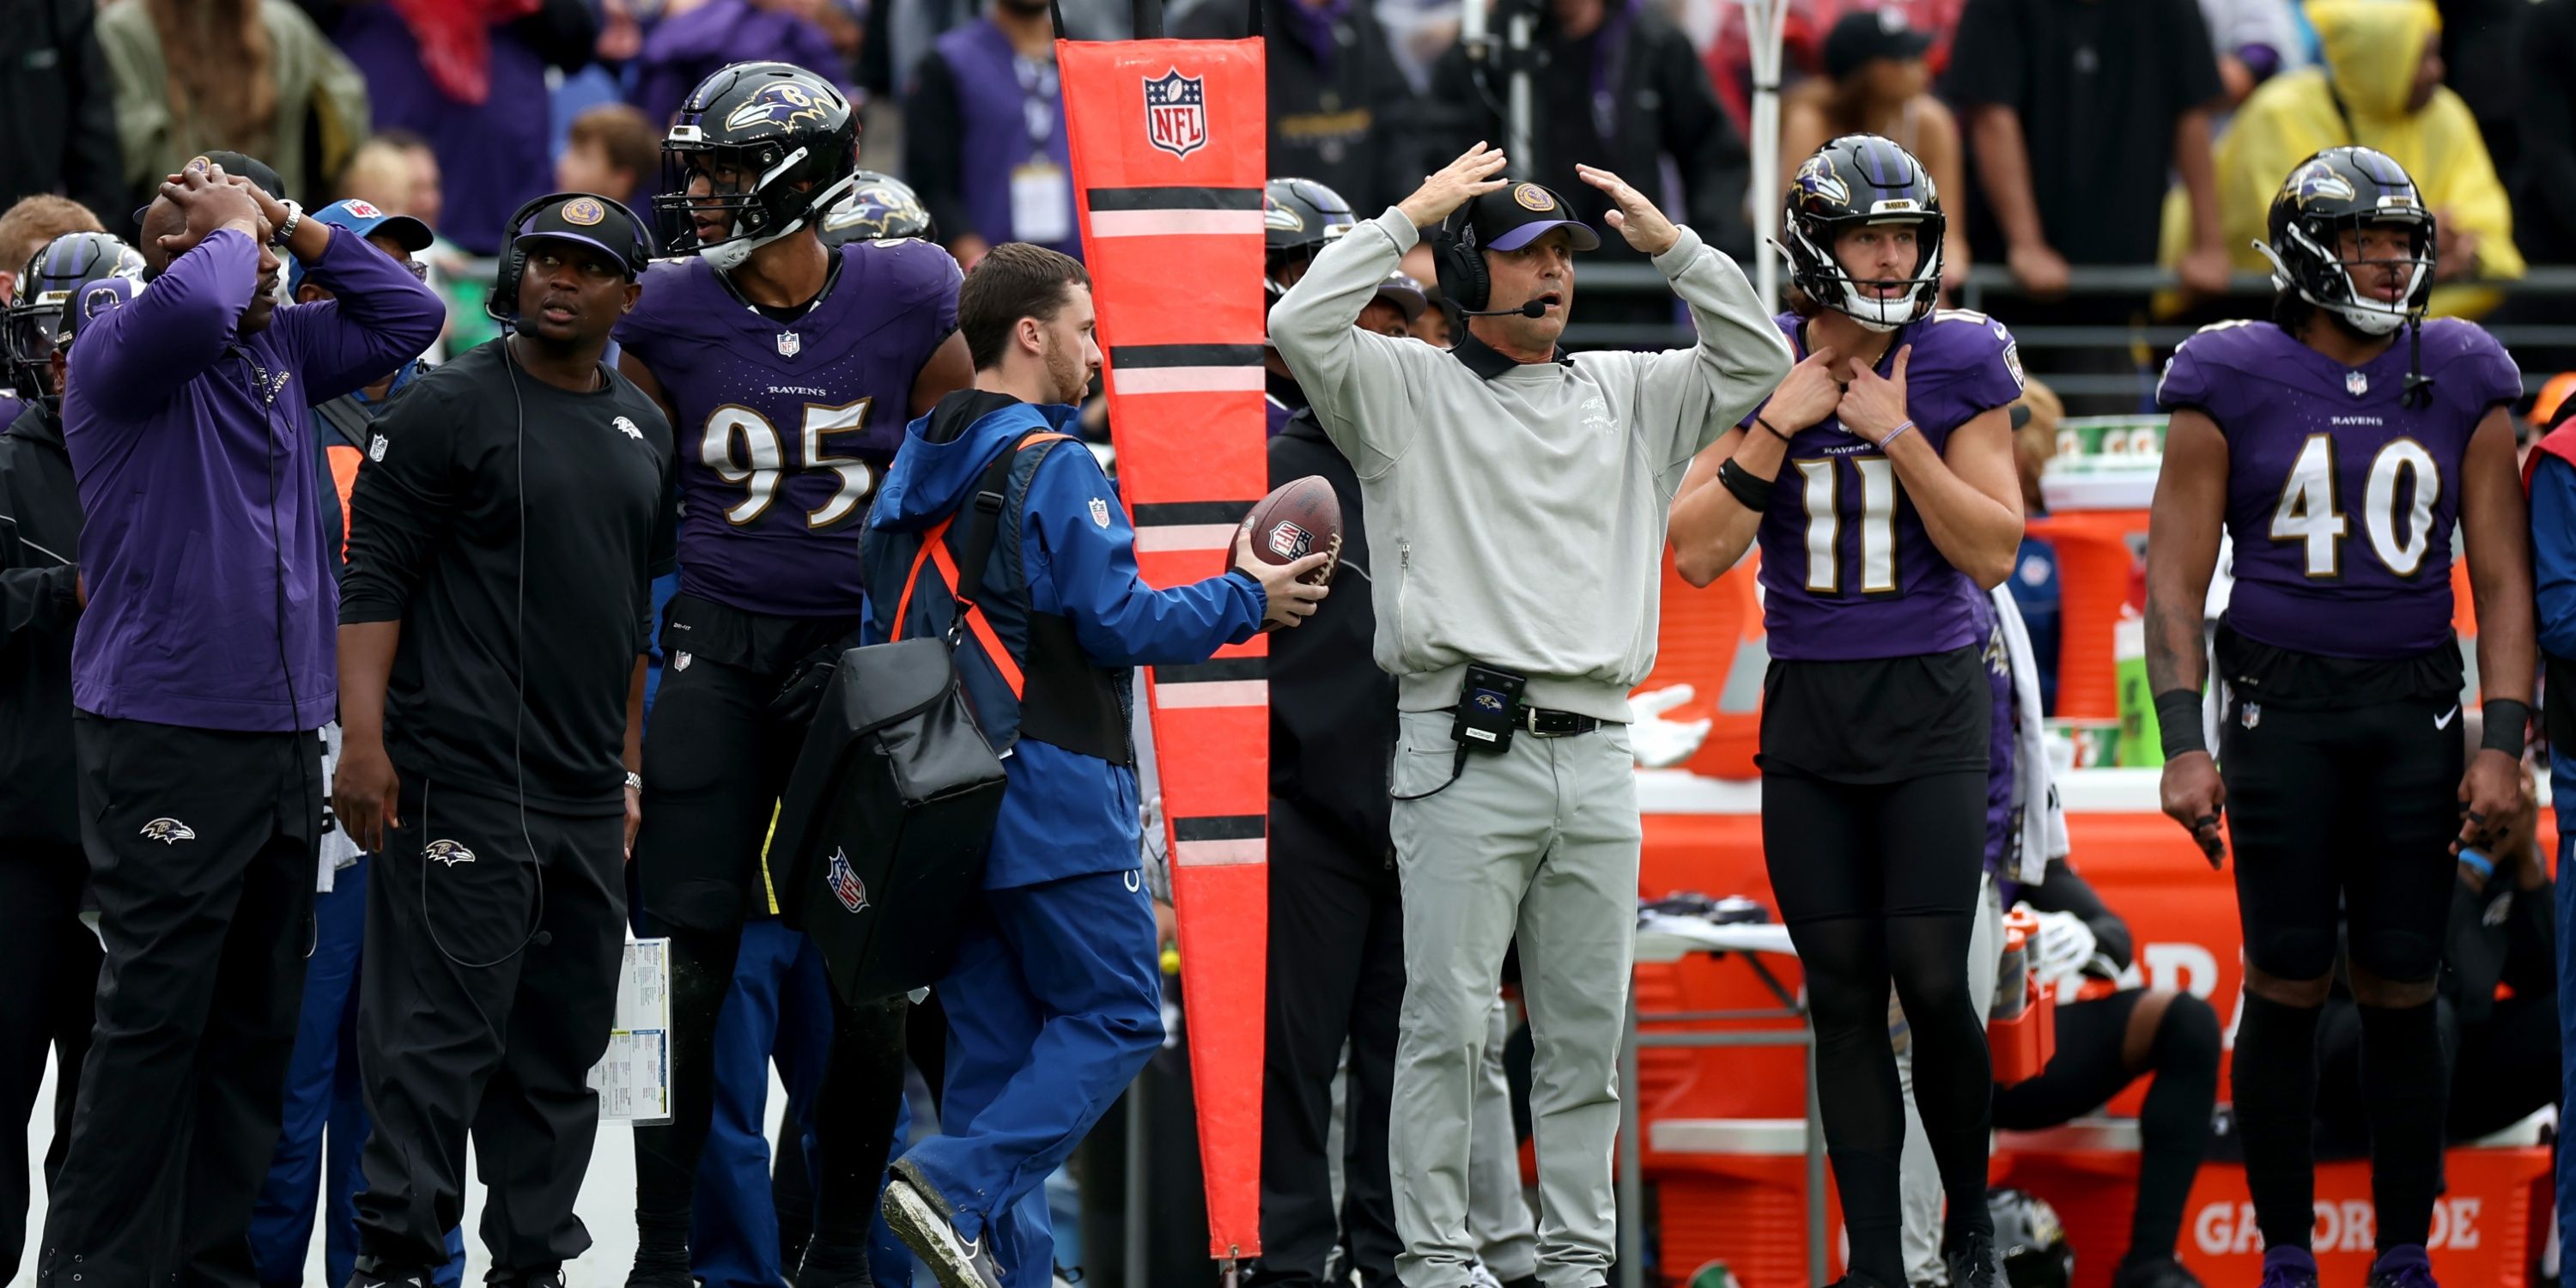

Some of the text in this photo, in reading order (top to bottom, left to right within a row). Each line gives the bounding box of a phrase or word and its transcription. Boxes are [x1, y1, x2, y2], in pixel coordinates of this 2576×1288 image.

[1153, 107, 1201, 148] NFL
[781, 342, 797, 353] NFL
[767, 385, 827, 397] RAVENS
[2330, 416, 2383, 426] RAVENS
[699, 397, 872, 528] 95
[1822, 442, 1872, 453] RAVENS
[2269, 433, 2443, 577] 40
[1274, 524, 1300, 551] NFL
[1792, 455, 1897, 592] 11
[839, 873, 862, 908] NFL
[2194, 1198, 2481, 1255] GAORDE
